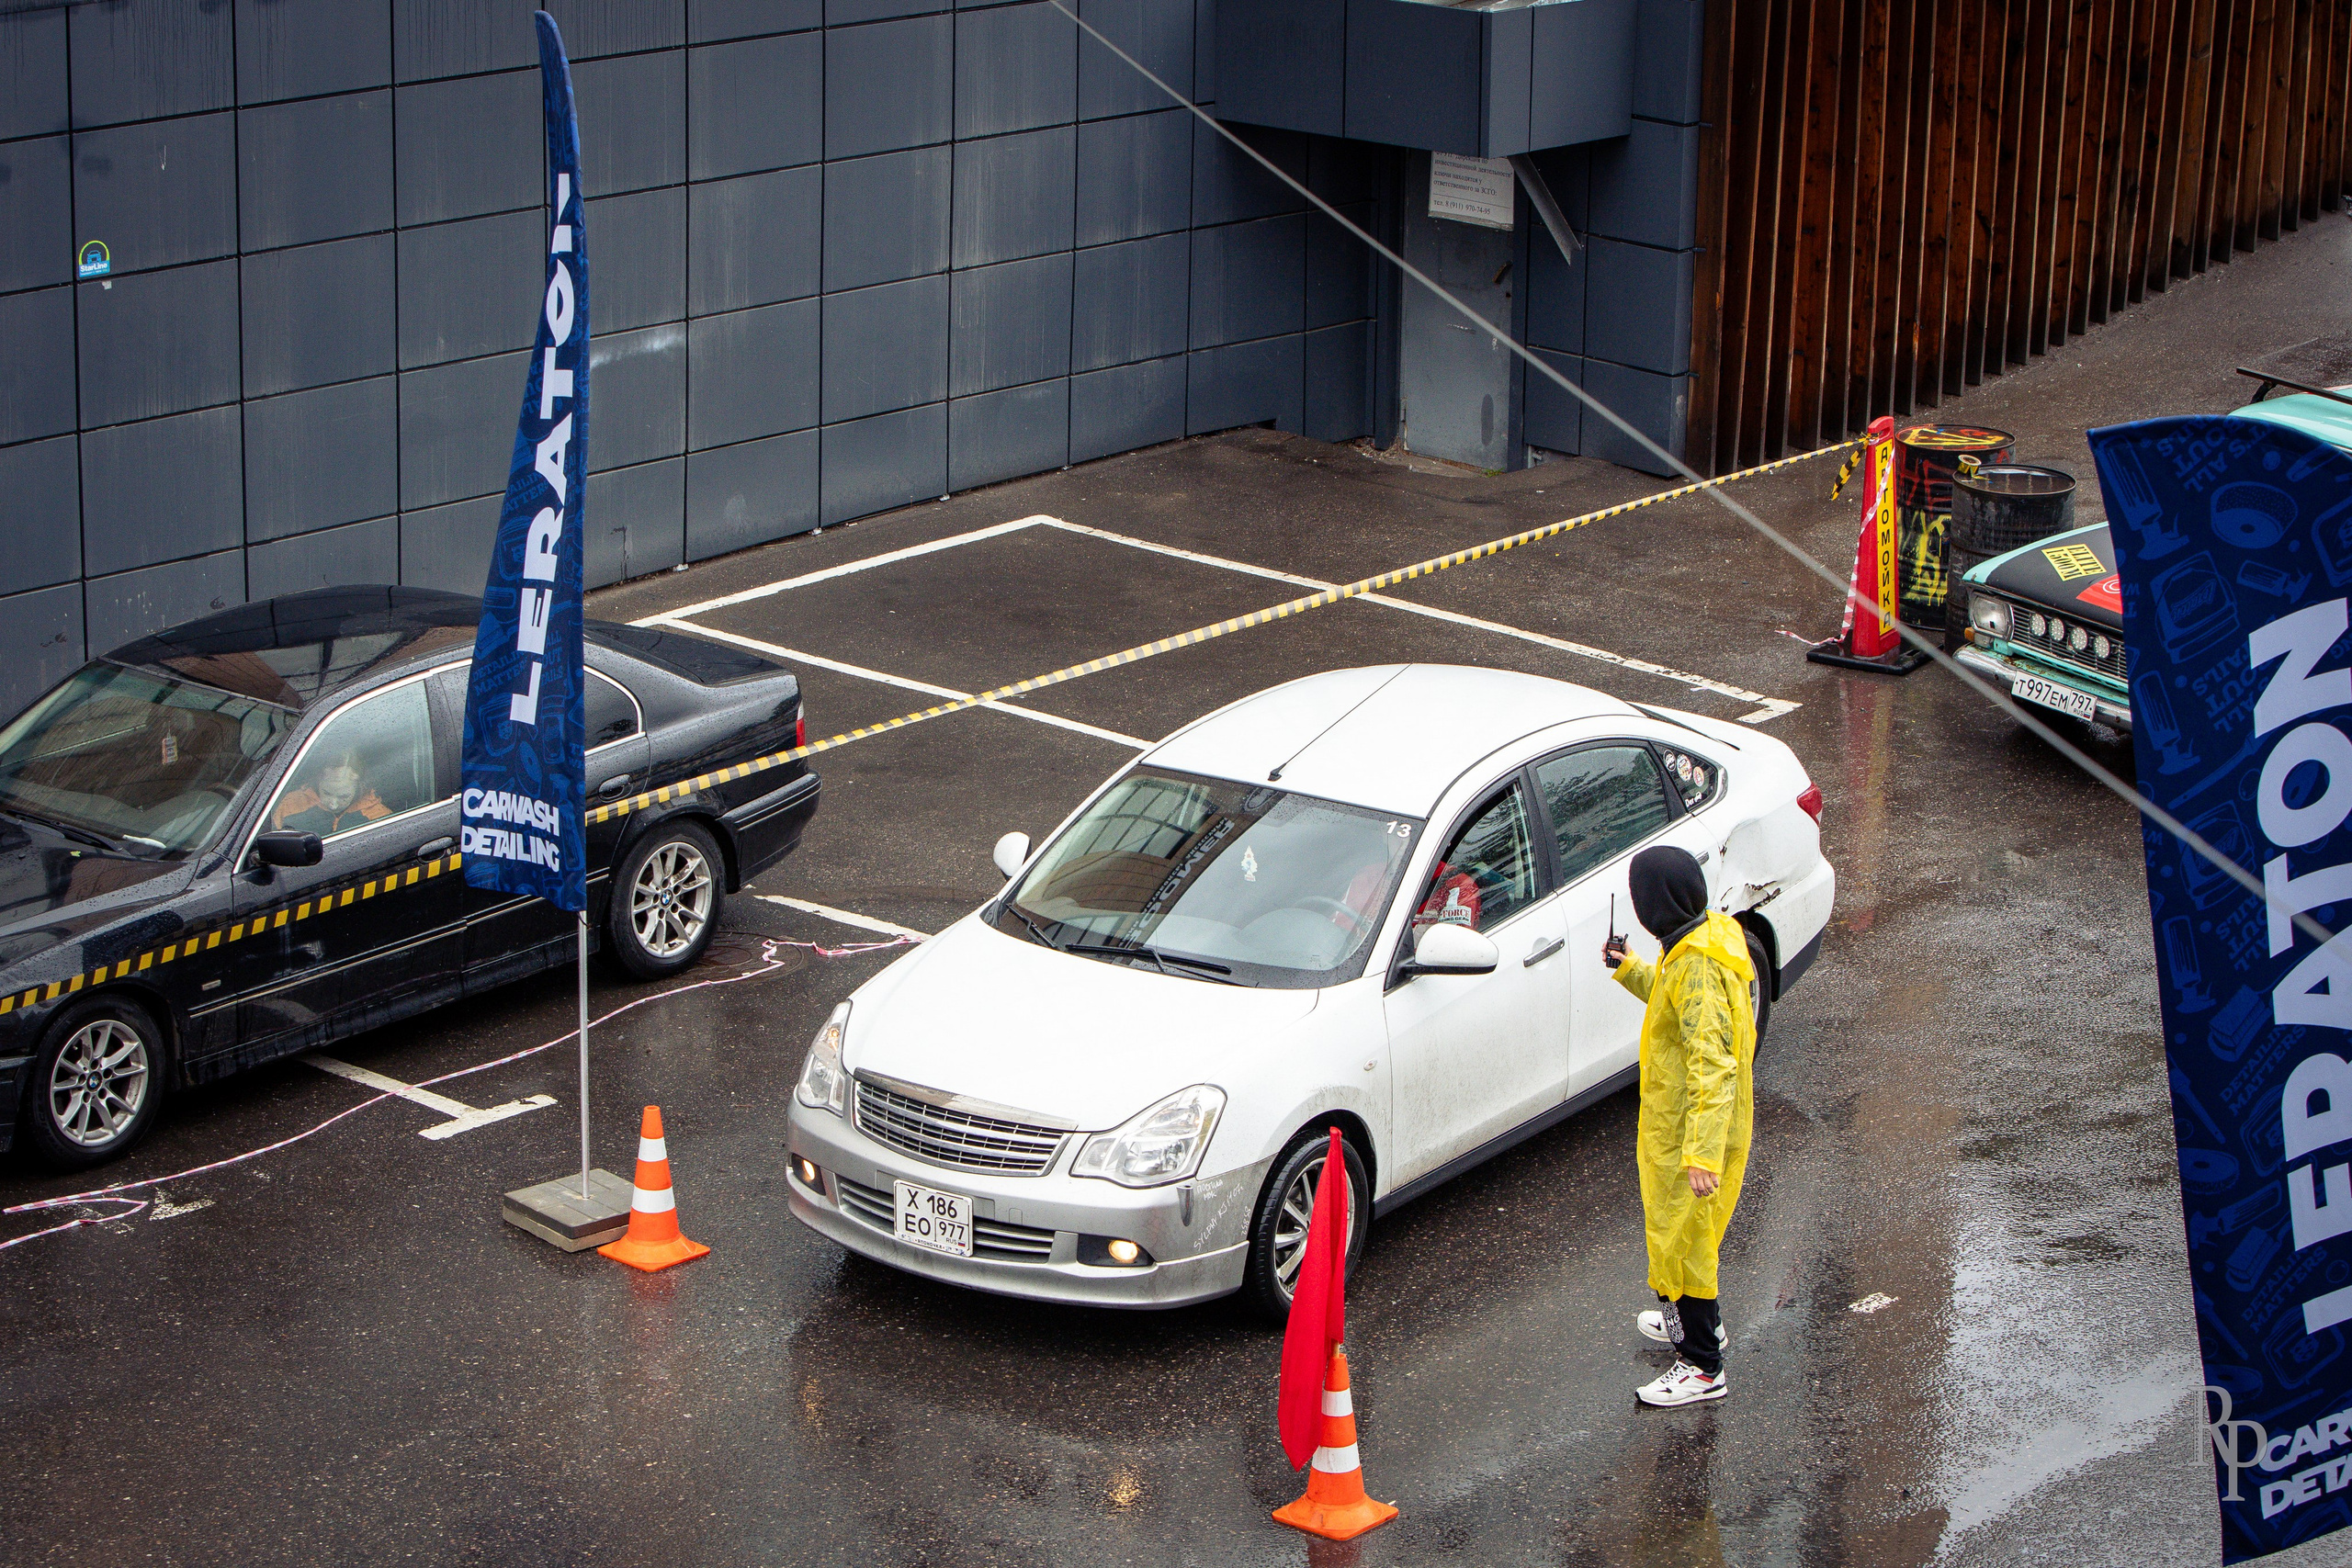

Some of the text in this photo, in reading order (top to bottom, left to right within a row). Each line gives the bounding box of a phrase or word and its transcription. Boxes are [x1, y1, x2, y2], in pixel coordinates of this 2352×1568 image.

[1433, 180, 1473, 191] ответственного
[1453, 174, 1478, 184] находятся
[80, 262, 107, 272] StarLine
[2067, 547, 2103, 574] ELITE
[2199, 663, 2262, 718] OUT
[2071, 692, 2092, 711] 797
[2073, 708, 2084, 716] RUS
[462, 788, 560, 836] CARWASH
[1386, 820, 1412, 838] 13
[461, 825, 560, 872] DETAILING
[2221, 1028, 2285, 1100] DETAILIN
[926, 1195, 957, 1219] 186
[939, 1221, 965, 1240] 977
[945, 1237, 957, 1246] RUS
[2243, 1252, 2306, 1319] DETAILIN
[2258, 1407, 2352, 1472] CAR
